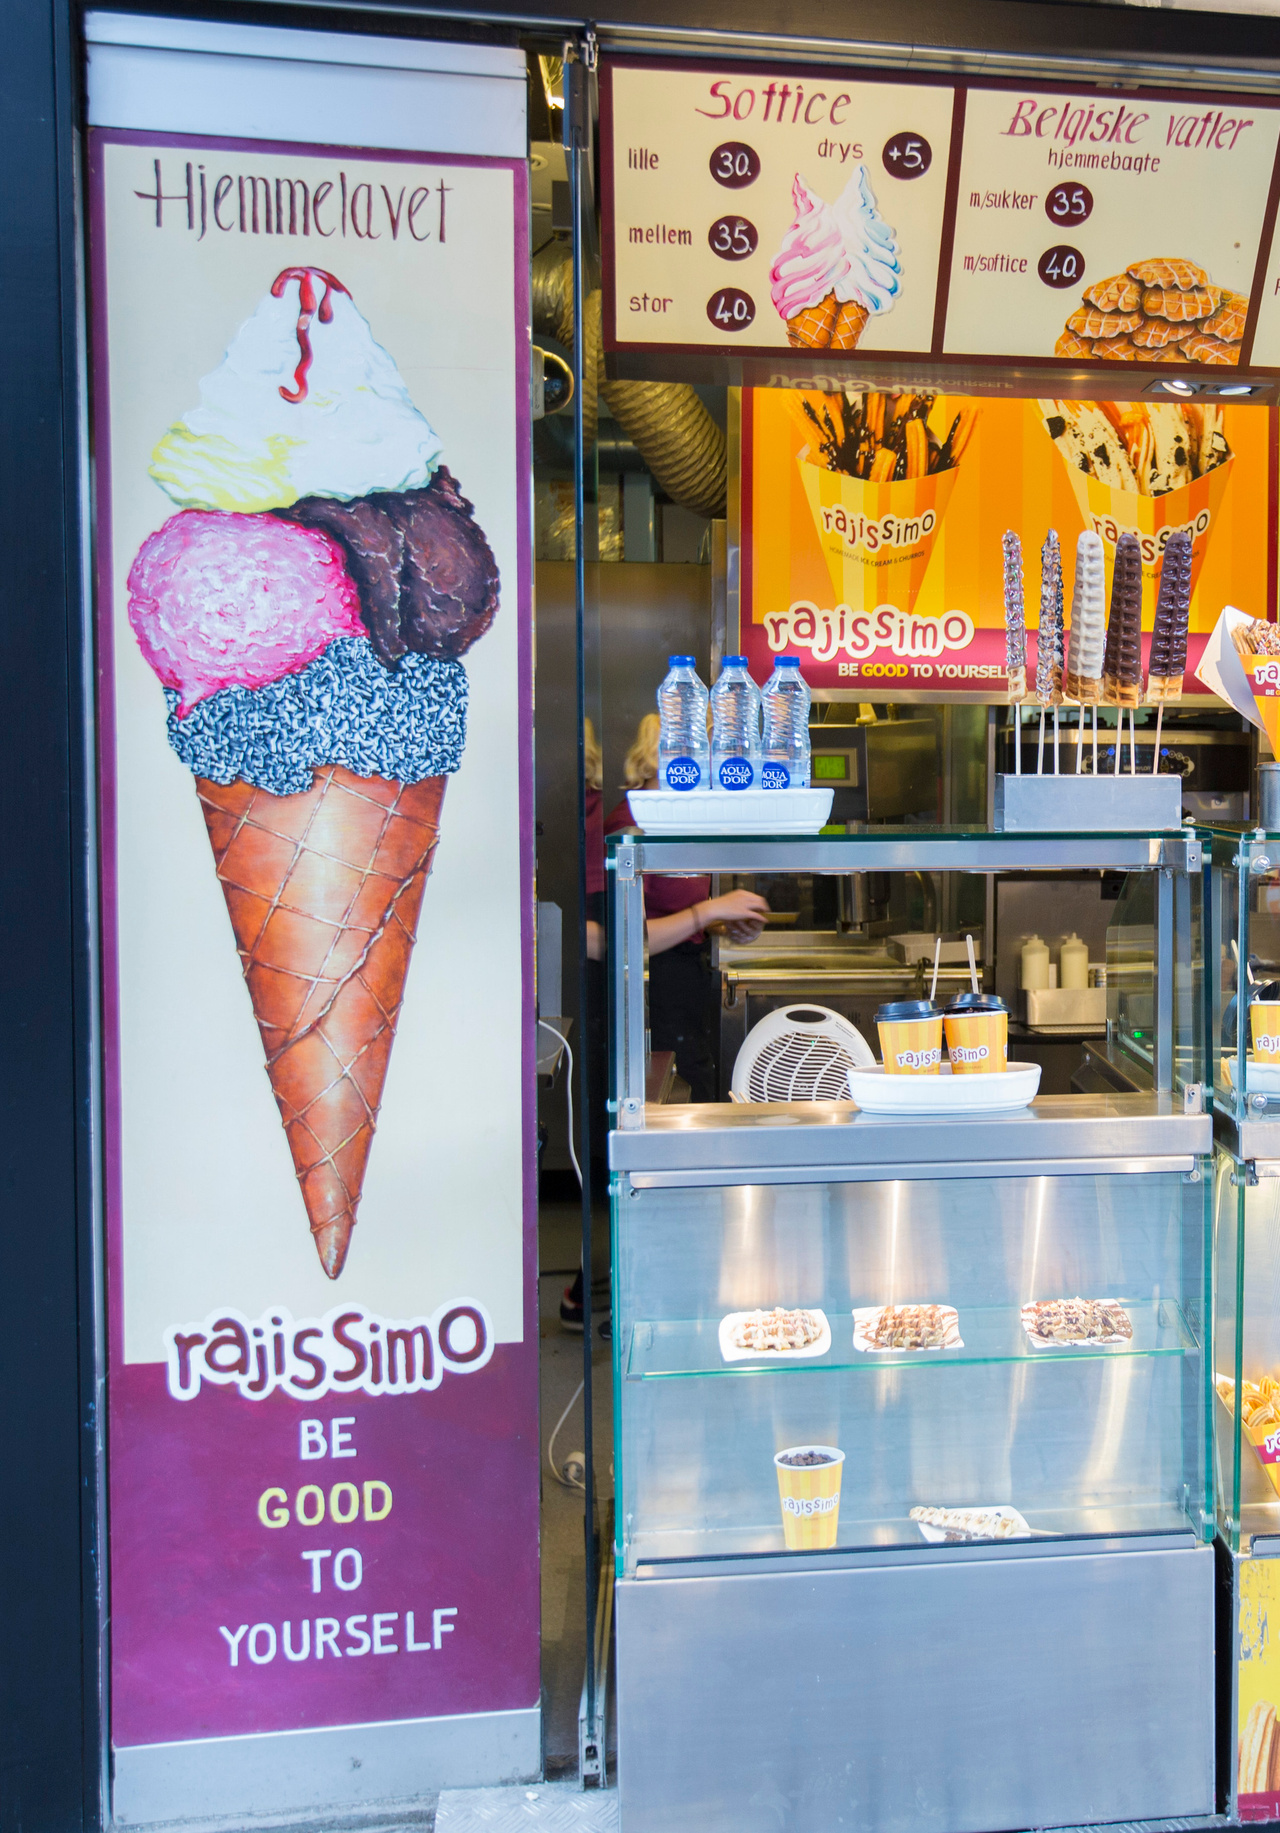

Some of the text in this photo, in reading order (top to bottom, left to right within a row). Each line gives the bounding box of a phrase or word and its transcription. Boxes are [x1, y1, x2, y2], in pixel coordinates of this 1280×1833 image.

[998, 99, 1150, 149] Belgiske
[628, 147, 659, 171] lille
[818, 138, 864, 163] drys
[1047, 148, 1161, 175] hjemmebagte
[134, 159, 454, 243] Hjemmelavet
[970, 189, 1038, 211] m/sukker
[628, 223, 692, 246] mellem
[963, 252, 1028, 274] m/softice
[628, 293, 673, 314] stor
[823, 509, 934, 549] rajissimo
[860, 558, 870, 566] ICE
[870, 558, 893, 568] CREAM
[898, 551, 925, 563] CHURROS
[769, 606, 967, 653] rajissimo
[838, 663, 858, 677] BE
[861, 663, 908, 678] GOOD
[911, 664, 933, 678] TO
[668, 766, 699, 776] AQUA
[721, 766, 751, 776] AQUA
[173, 1305, 488, 1392] rajissimo
[300, 1417, 357, 1460] BE
[258, 1480, 393, 1529] GOOD
[784, 1494, 838, 1514] rajissimo
[302, 1547, 363, 1593] TO
[219, 1607, 458, 1667] YOURSELF
